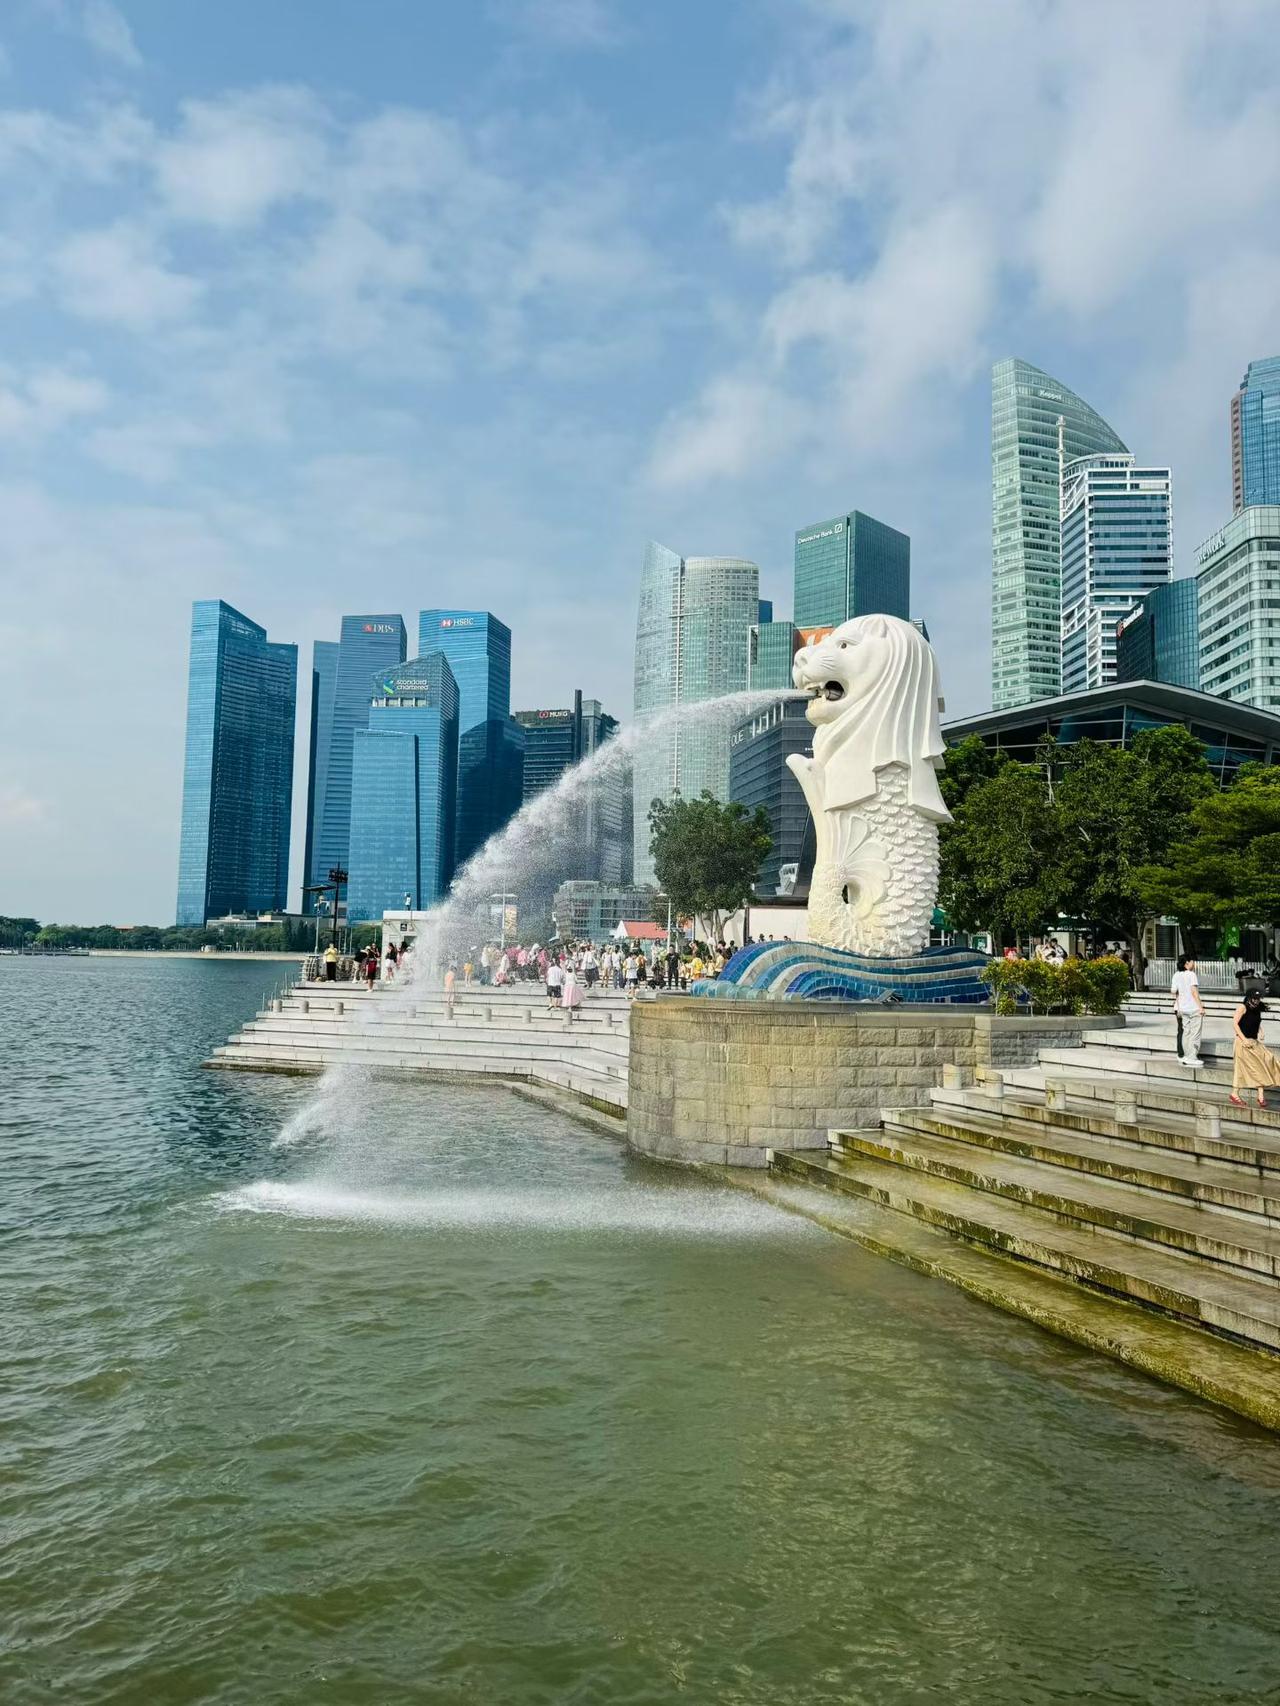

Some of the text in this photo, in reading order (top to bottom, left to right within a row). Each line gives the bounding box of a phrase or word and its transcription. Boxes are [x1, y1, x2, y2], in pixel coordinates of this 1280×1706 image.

[820, 529, 833, 538] Bank
[453, 618, 474, 626] HSBC
[373, 624, 394, 632] DBS
